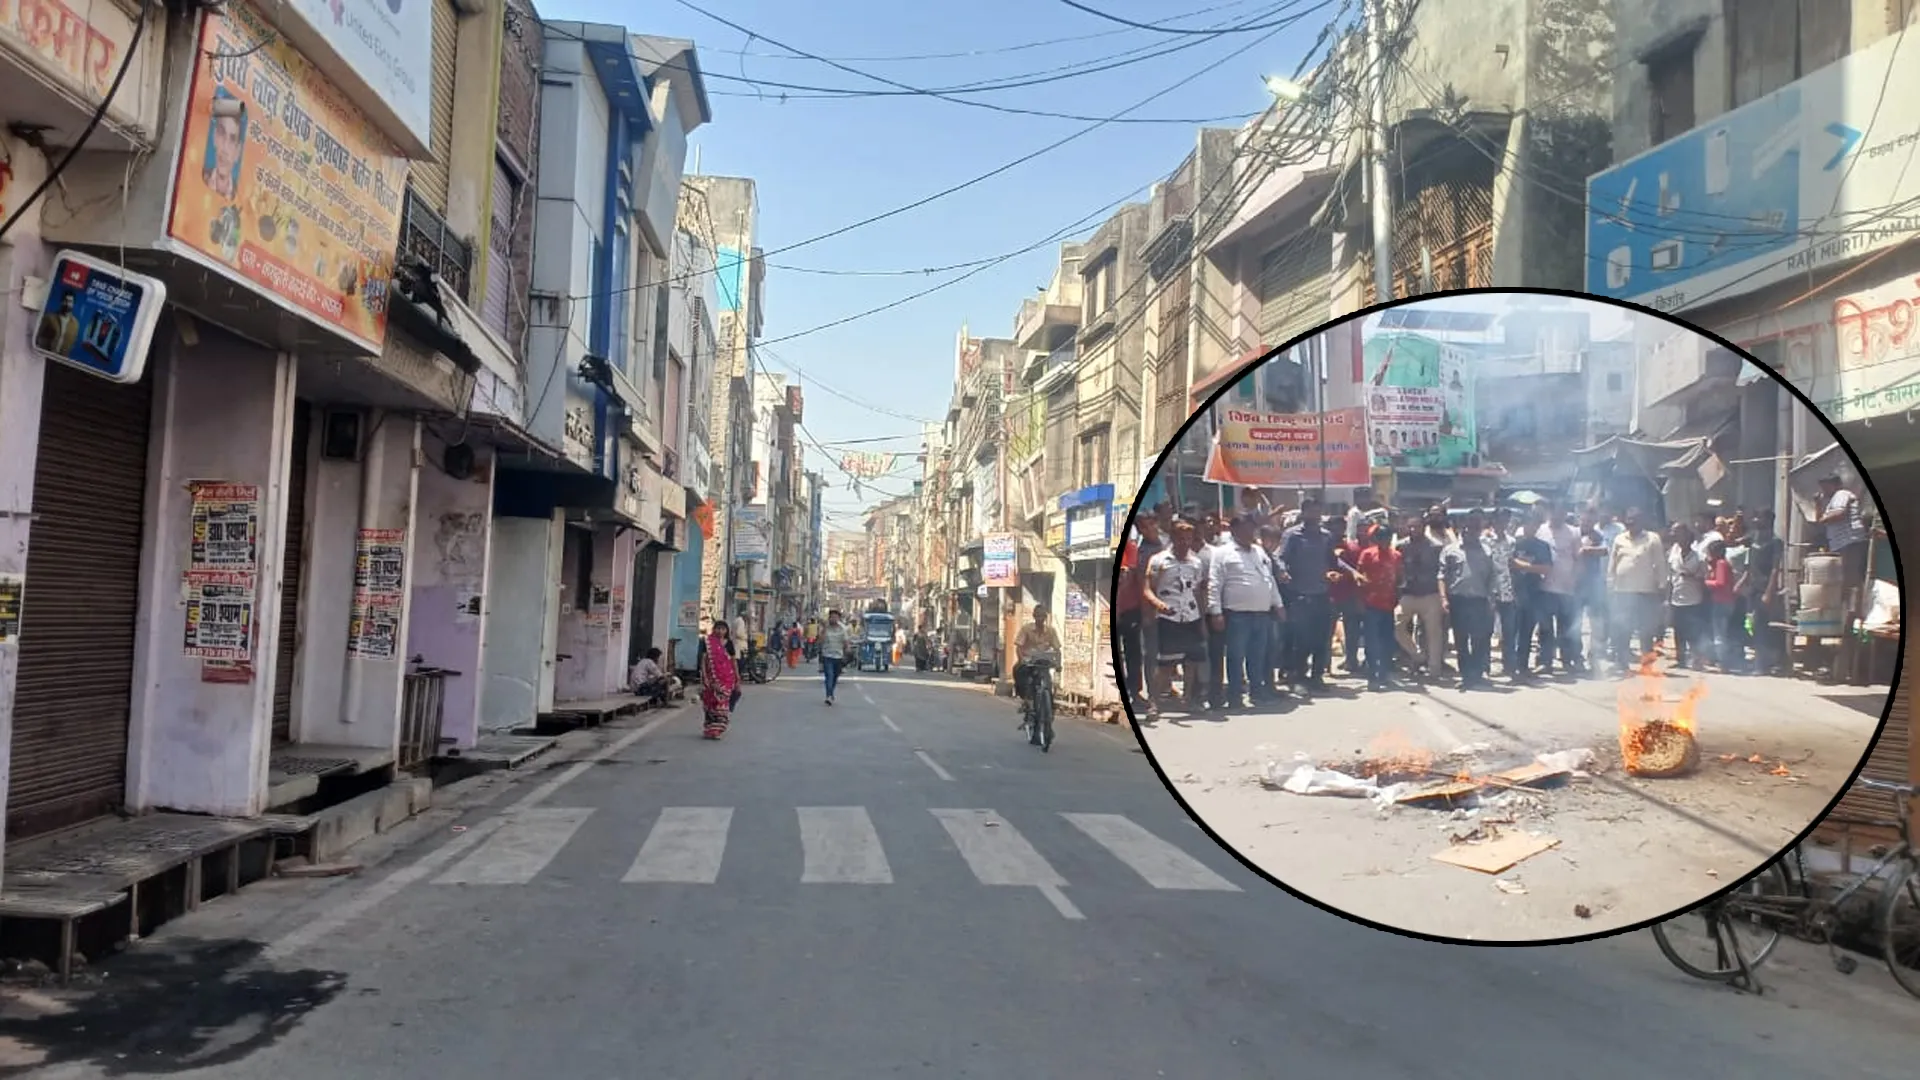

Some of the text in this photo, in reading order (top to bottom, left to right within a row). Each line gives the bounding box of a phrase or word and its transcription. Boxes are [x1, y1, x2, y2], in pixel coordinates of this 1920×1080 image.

[282, 90, 313, 142] दीपक
[314, 123, 350, 175] कुशवाह
[1787, 246, 1816, 271] RAM
[1821, 233, 1864, 260] MURTI
[1227, 410, 1260, 424] विश्व
[225, 521, 248, 541] श्याम
[219, 602, 241, 622] श्याम
